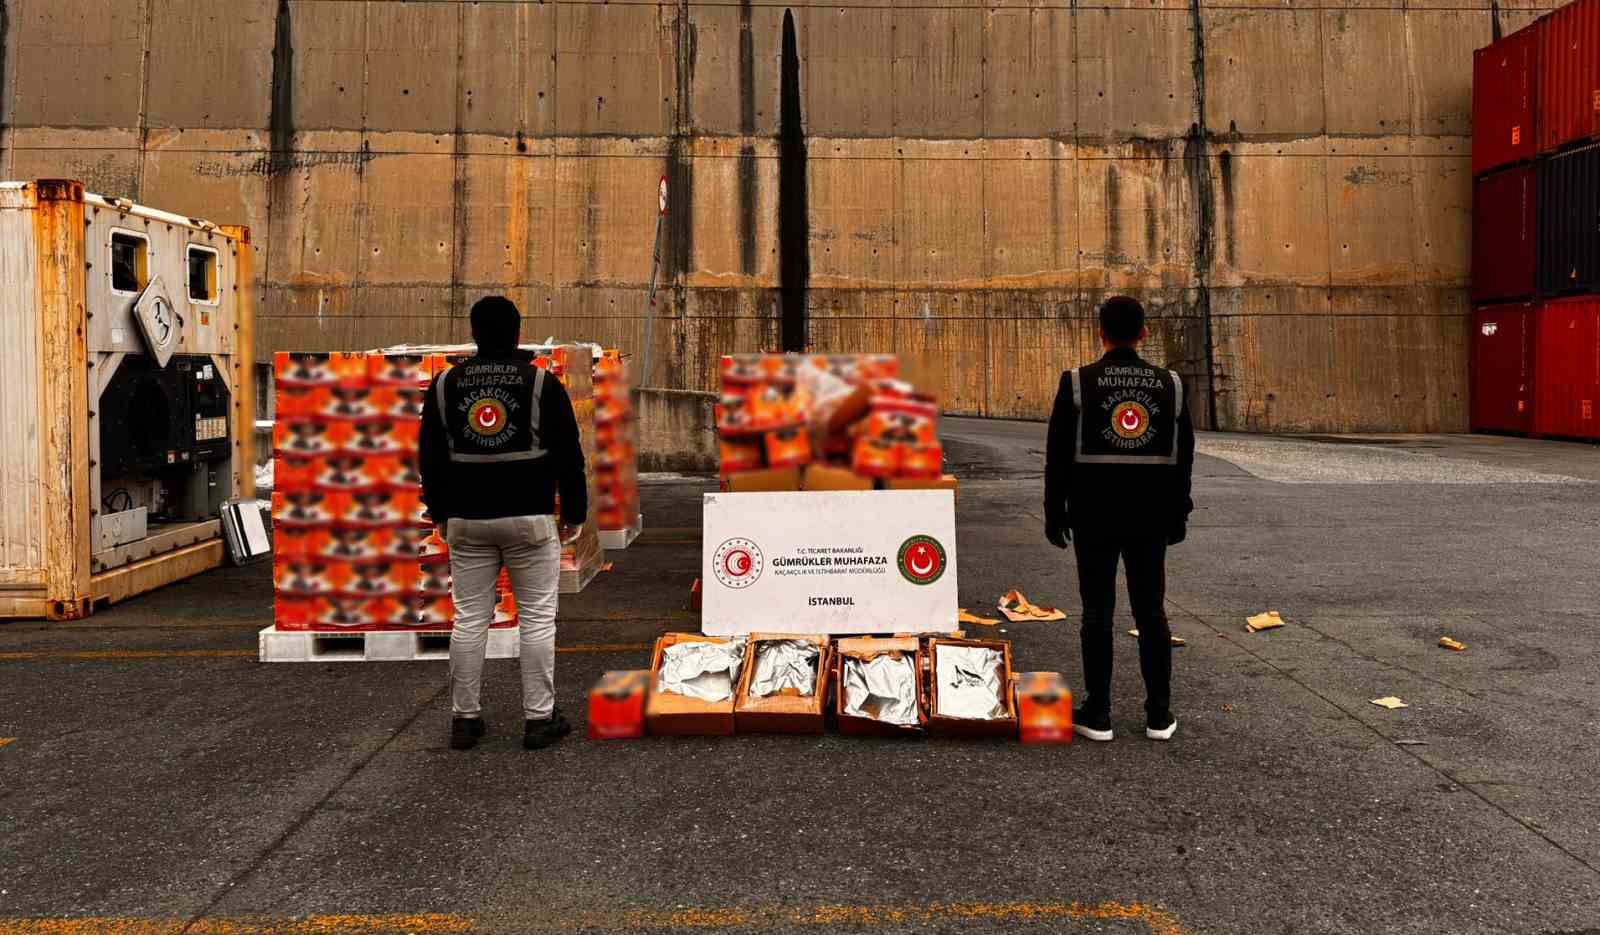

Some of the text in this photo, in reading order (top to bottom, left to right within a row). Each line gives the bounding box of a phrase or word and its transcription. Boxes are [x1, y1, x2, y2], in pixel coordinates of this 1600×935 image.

[456, 375, 524, 388] MUHAFAZA
[1097, 377, 1164, 389] MUHAFAZA
[457, 387, 520, 412] KAÇAKÇILIK
[1100, 388, 1161, 415] KAÇAKÇILIK
[832, 546, 864, 554] BAKANLIĞI
[772, 556, 887, 567] GÜMRÜKLER MUHAFAZA
[808, 596, 855, 606] İSTANBUL
